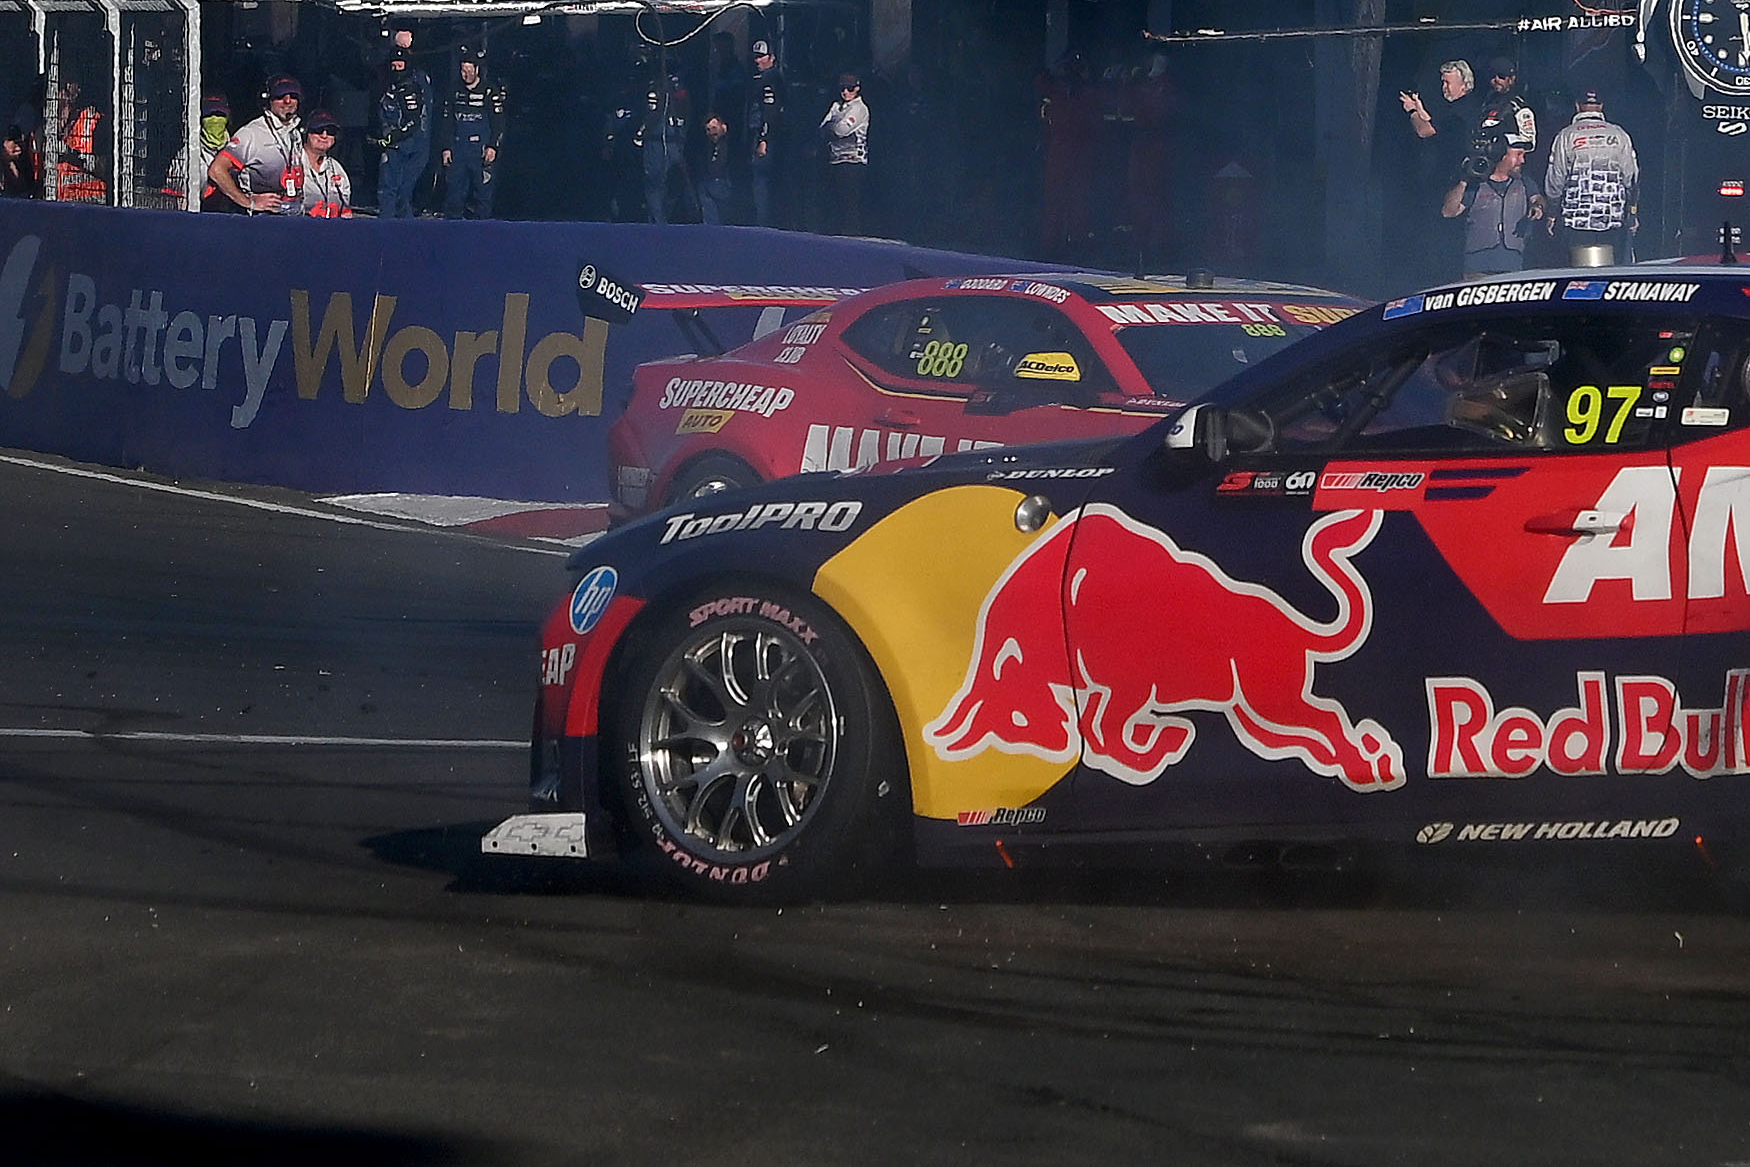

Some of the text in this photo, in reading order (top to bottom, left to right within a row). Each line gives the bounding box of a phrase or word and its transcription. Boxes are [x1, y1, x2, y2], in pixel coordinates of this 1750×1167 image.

[595, 277, 640, 316] BOSCH
[1025, 281, 1072, 304] LOWNDES
[1425, 282, 1557, 311] van GISBERGEN
[1604, 281, 1701, 304] STANAWAY
[1096, 304, 1239, 326] MAKE
[1236, 303, 1283, 324] IT
[916, 340, 968, 379] 888
[659, 377, 796, 419] SUPERCHEAP
[681, 414, 723, 433] AUTO
[1564, 385, 1643, 445] 97
[1005, 468, 1116, 480] DUNLOP
[1360, 472, 1425, 493] Repco
[577, 574, 613, 621] hp
[689, 597, 819, 644] SPORT MAXX
[1457, 817, 1681, 842] NEW HOLLAND
